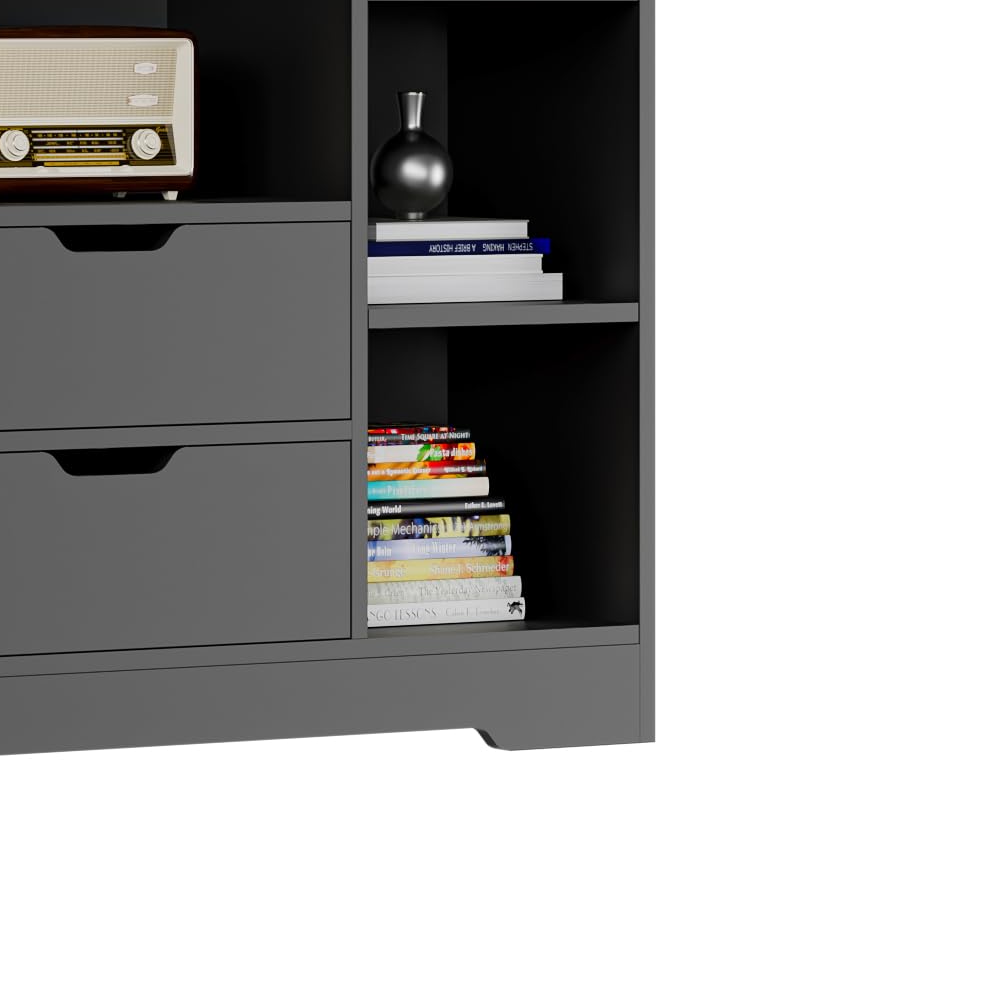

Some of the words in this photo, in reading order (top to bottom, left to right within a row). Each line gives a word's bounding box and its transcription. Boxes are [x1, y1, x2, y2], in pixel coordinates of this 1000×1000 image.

[428, 244, 452, 253] HISTORY
[452, 243, 471, 252] BRIEF
[471, 243, 477, 252] A
[507, 242, 534, 252] STEPHEN
[401, 433, 416, 441] TIME
[416, 433, 439, 442] SQUARE
[381, 505, 402, 514] World
